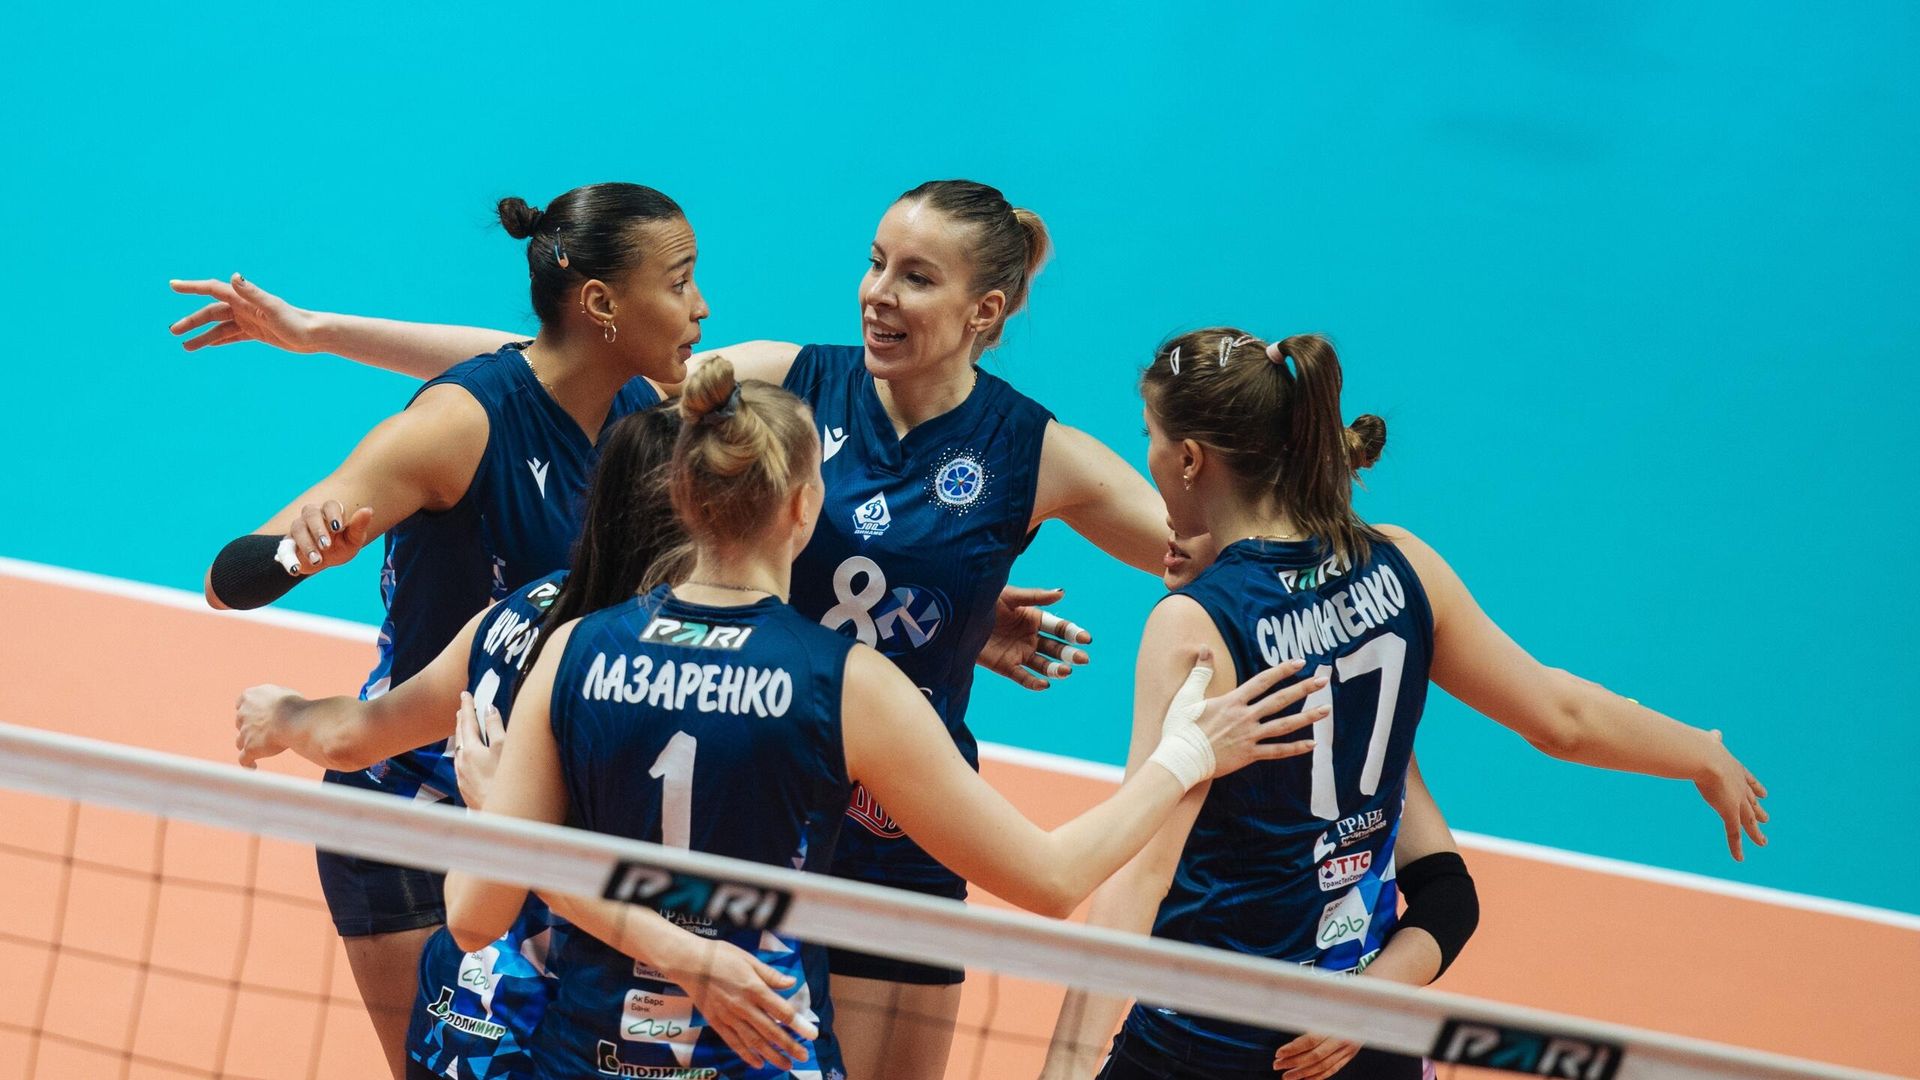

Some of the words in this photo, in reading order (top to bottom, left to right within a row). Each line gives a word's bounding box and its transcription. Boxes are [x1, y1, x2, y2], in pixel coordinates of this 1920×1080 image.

[642, 617, 753, 649] PARI
[582, 651, 793, 719] ЛАЗАРЕНКО
[1302, 631, 1407, 821] 17
[648, 729, 698, 853] 1
[613, 863, 780, 929] PARI
[631, 994, 643, 1004] Ак
[643, 996, 665, 1006] Барс
[631, 1003, 651, 1012] Банк
[446, 1011, 506, 1038] ПОЛИМИР
[622, 1064, 717, 1080] ПОЛИМИР
[1442, 1022, 1612, 1080] PARI
